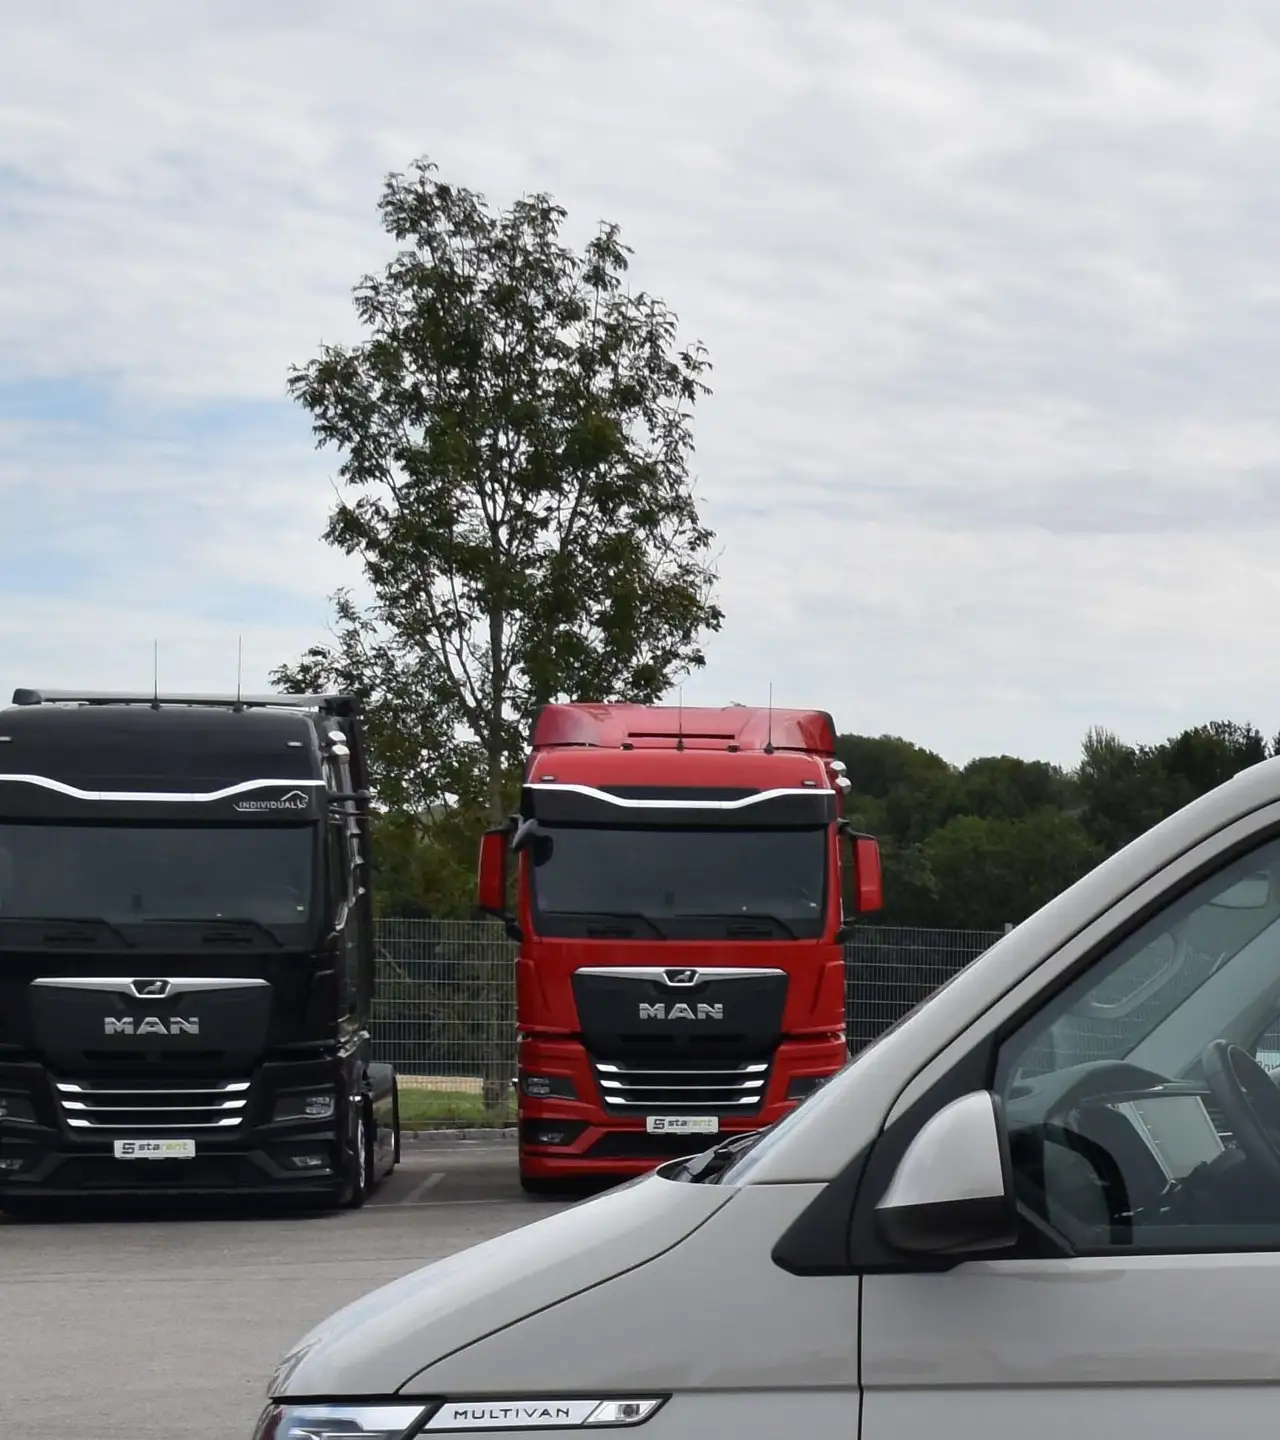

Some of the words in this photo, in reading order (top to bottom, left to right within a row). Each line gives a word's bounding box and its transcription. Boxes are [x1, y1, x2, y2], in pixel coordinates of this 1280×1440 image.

[239, 801, 297, 809] INDIVIDUAL
[639, 1003, 723, 1020] MAN
[104, 1017, 200, 1034] MAN
[453, 1408, 570, 1420] MULTIVAN
